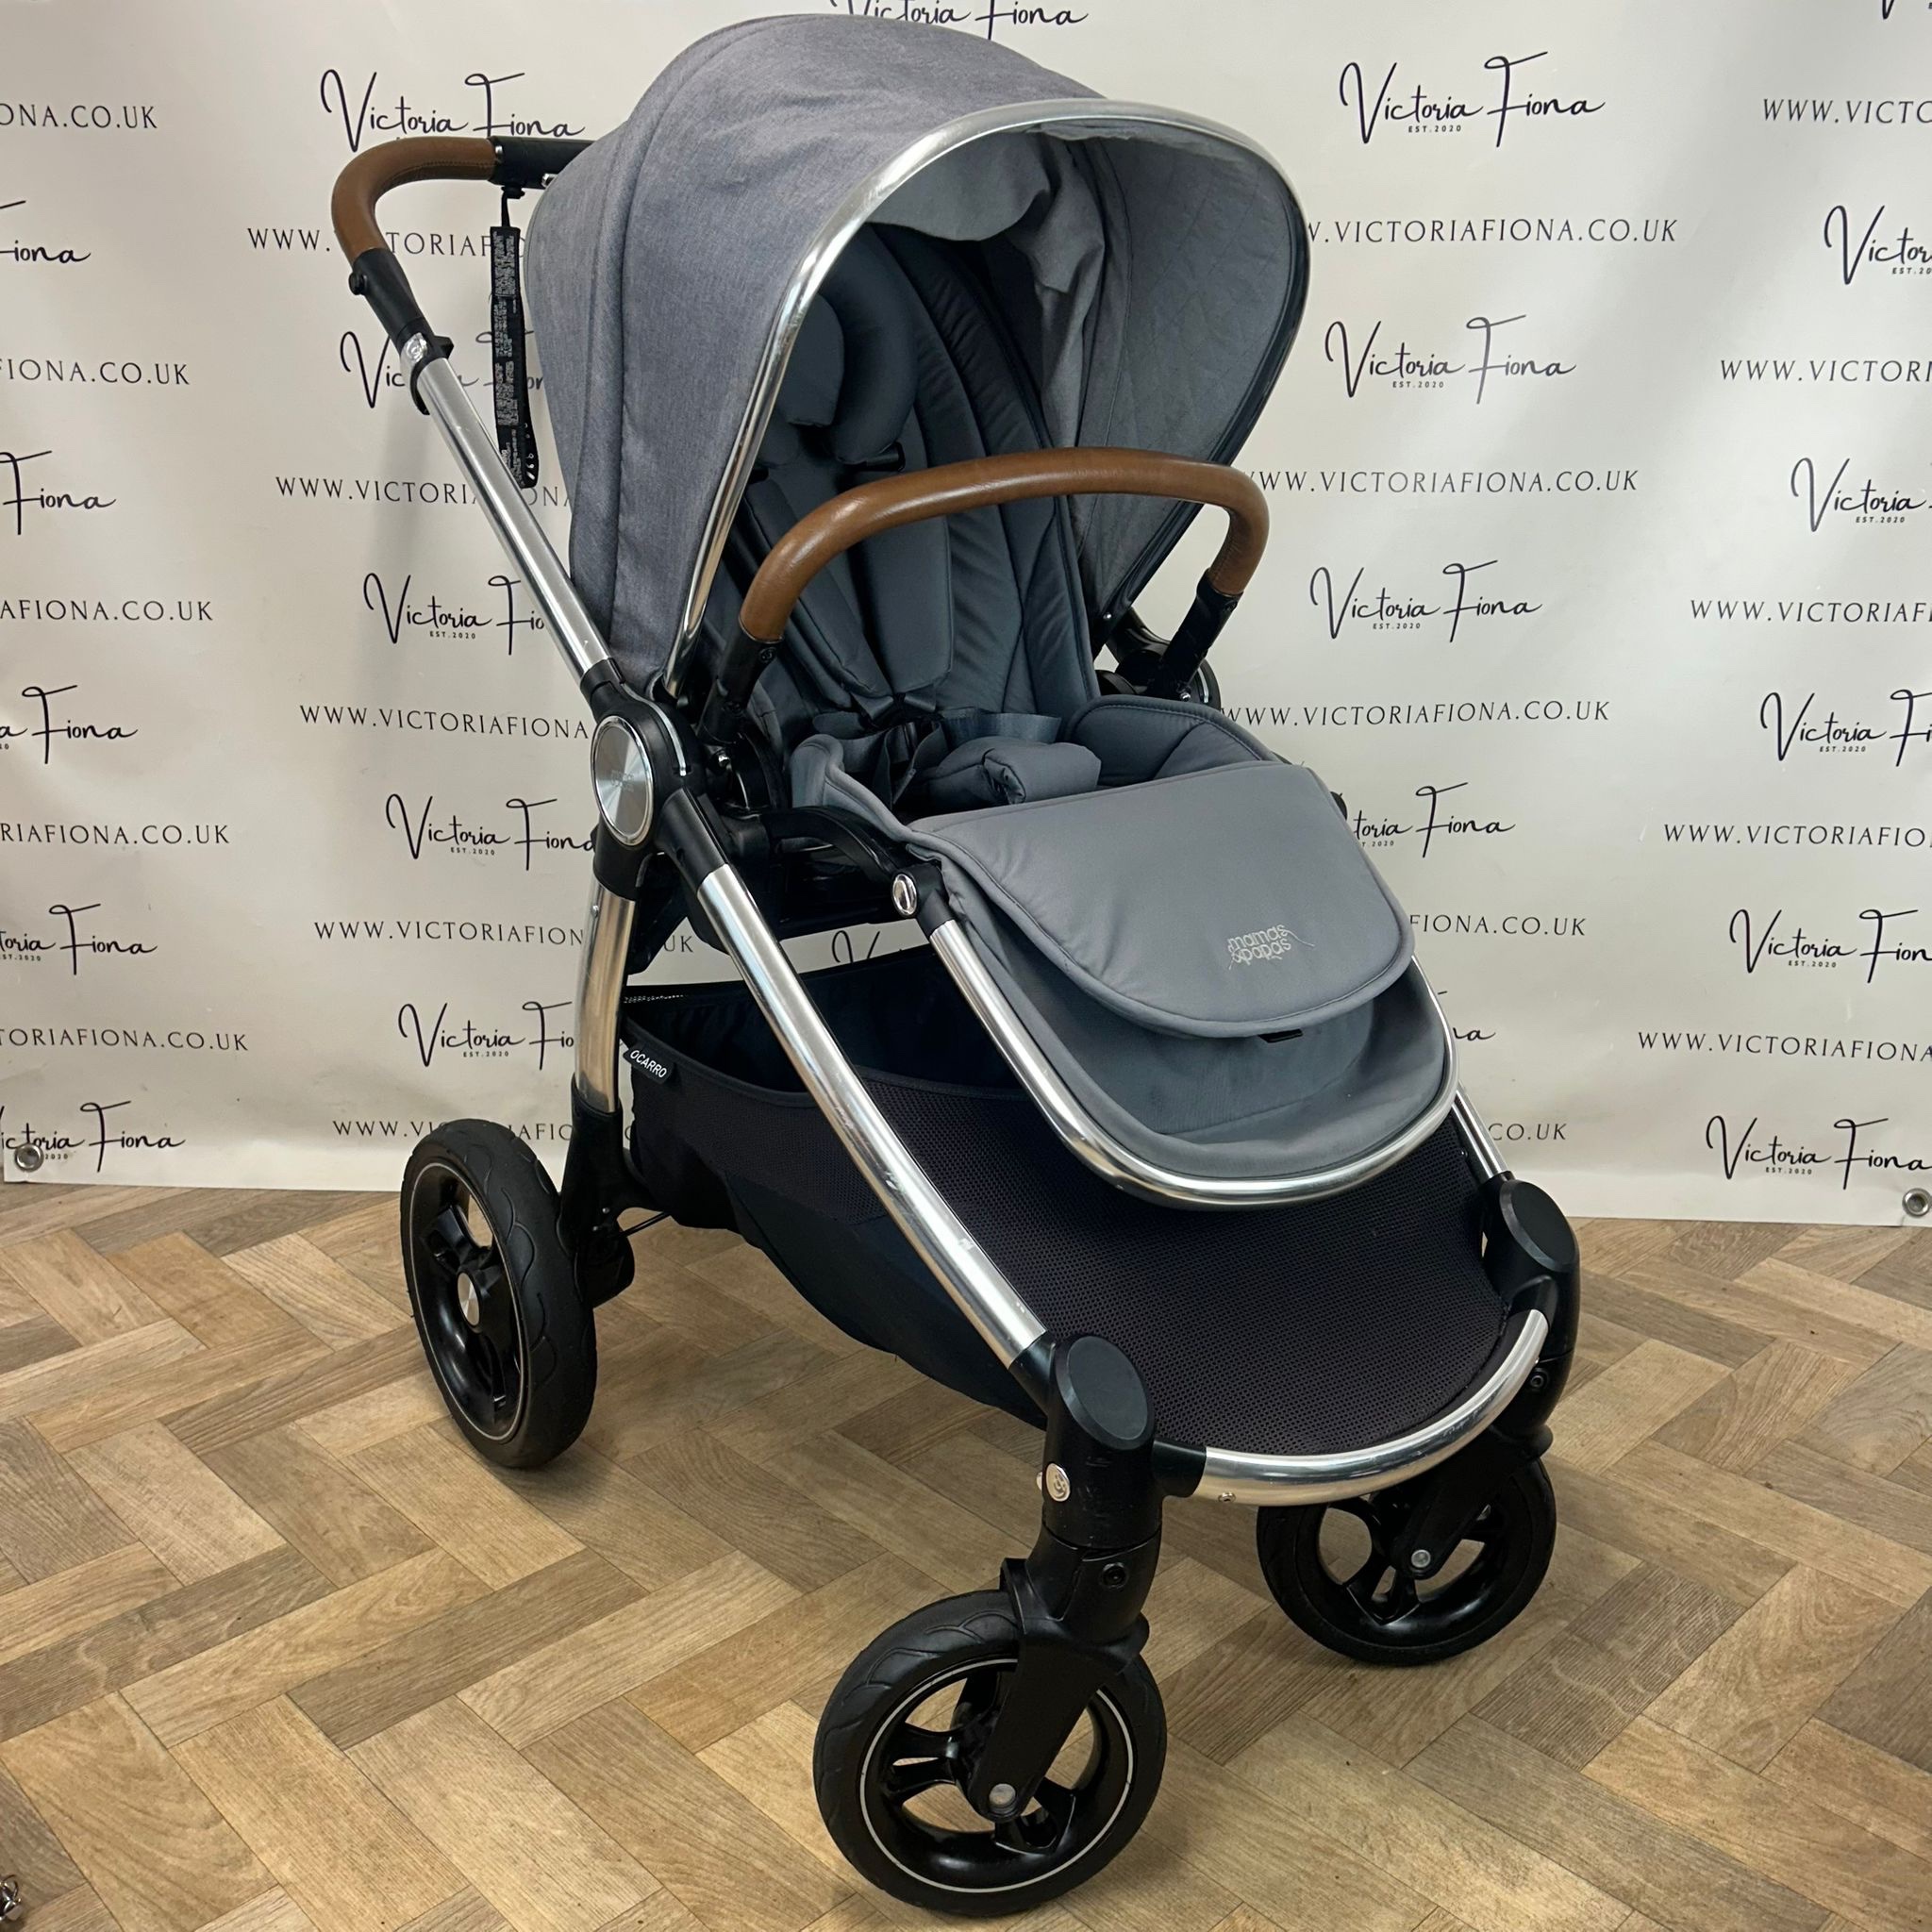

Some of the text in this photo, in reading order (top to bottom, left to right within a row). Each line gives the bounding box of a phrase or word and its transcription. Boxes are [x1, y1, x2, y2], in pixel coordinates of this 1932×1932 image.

[830, 0, 972, 25] ictoria
[320, 69, 585, 153] Victoria Fiona
[1339, 51, 1606, 148] Victoria Fiona
[1407, 125, 1463, 134] EST.2020
[0, 199, 92, 264] iona
[0, 358, 191, 385] IONA.CO.UK
[1324, 314, 1577, 404] Victoria Fiona
[1391, 380, 1445, 389] EST.2020
[0, 450, 117, 535] Fiona
[1248, 470, 1640, 493] WW.VICTORIAFIONA.CO.UK
[1790, 458, 1927, 532] Victoria
[363, 573, 493, 644] Victoria
[1309, 559, 1543, 643] Victoria Fiona
[429, 630, 476, 640] EST.2020
[22, 684, 139, 765] Fiona
[1759, 691, 1888, 761] Victoria
[385, 793, 511, 859] Victoria
[450, 847, 495, 856] EST.2020
[1415, 782, 1517, 858] Fiona
[1662, 824, 1932, 848] WWW.VICTORIAFIO
[49, 903, 158, 975] Fiona
[1728, 908, 1857, 974] Victoria
[1788, 959, 1837, 968] EST.2020
[398, 1002, 526, 1068] Victoria
[629, 1049, 668, 1078] OCARRO
[0, 1100, 187, 1174] ictoria Fiona
[1706, 1115, 1932, 1191] Victoria Fiona
[1765, 1167, 1813, 1175] EST.2020
